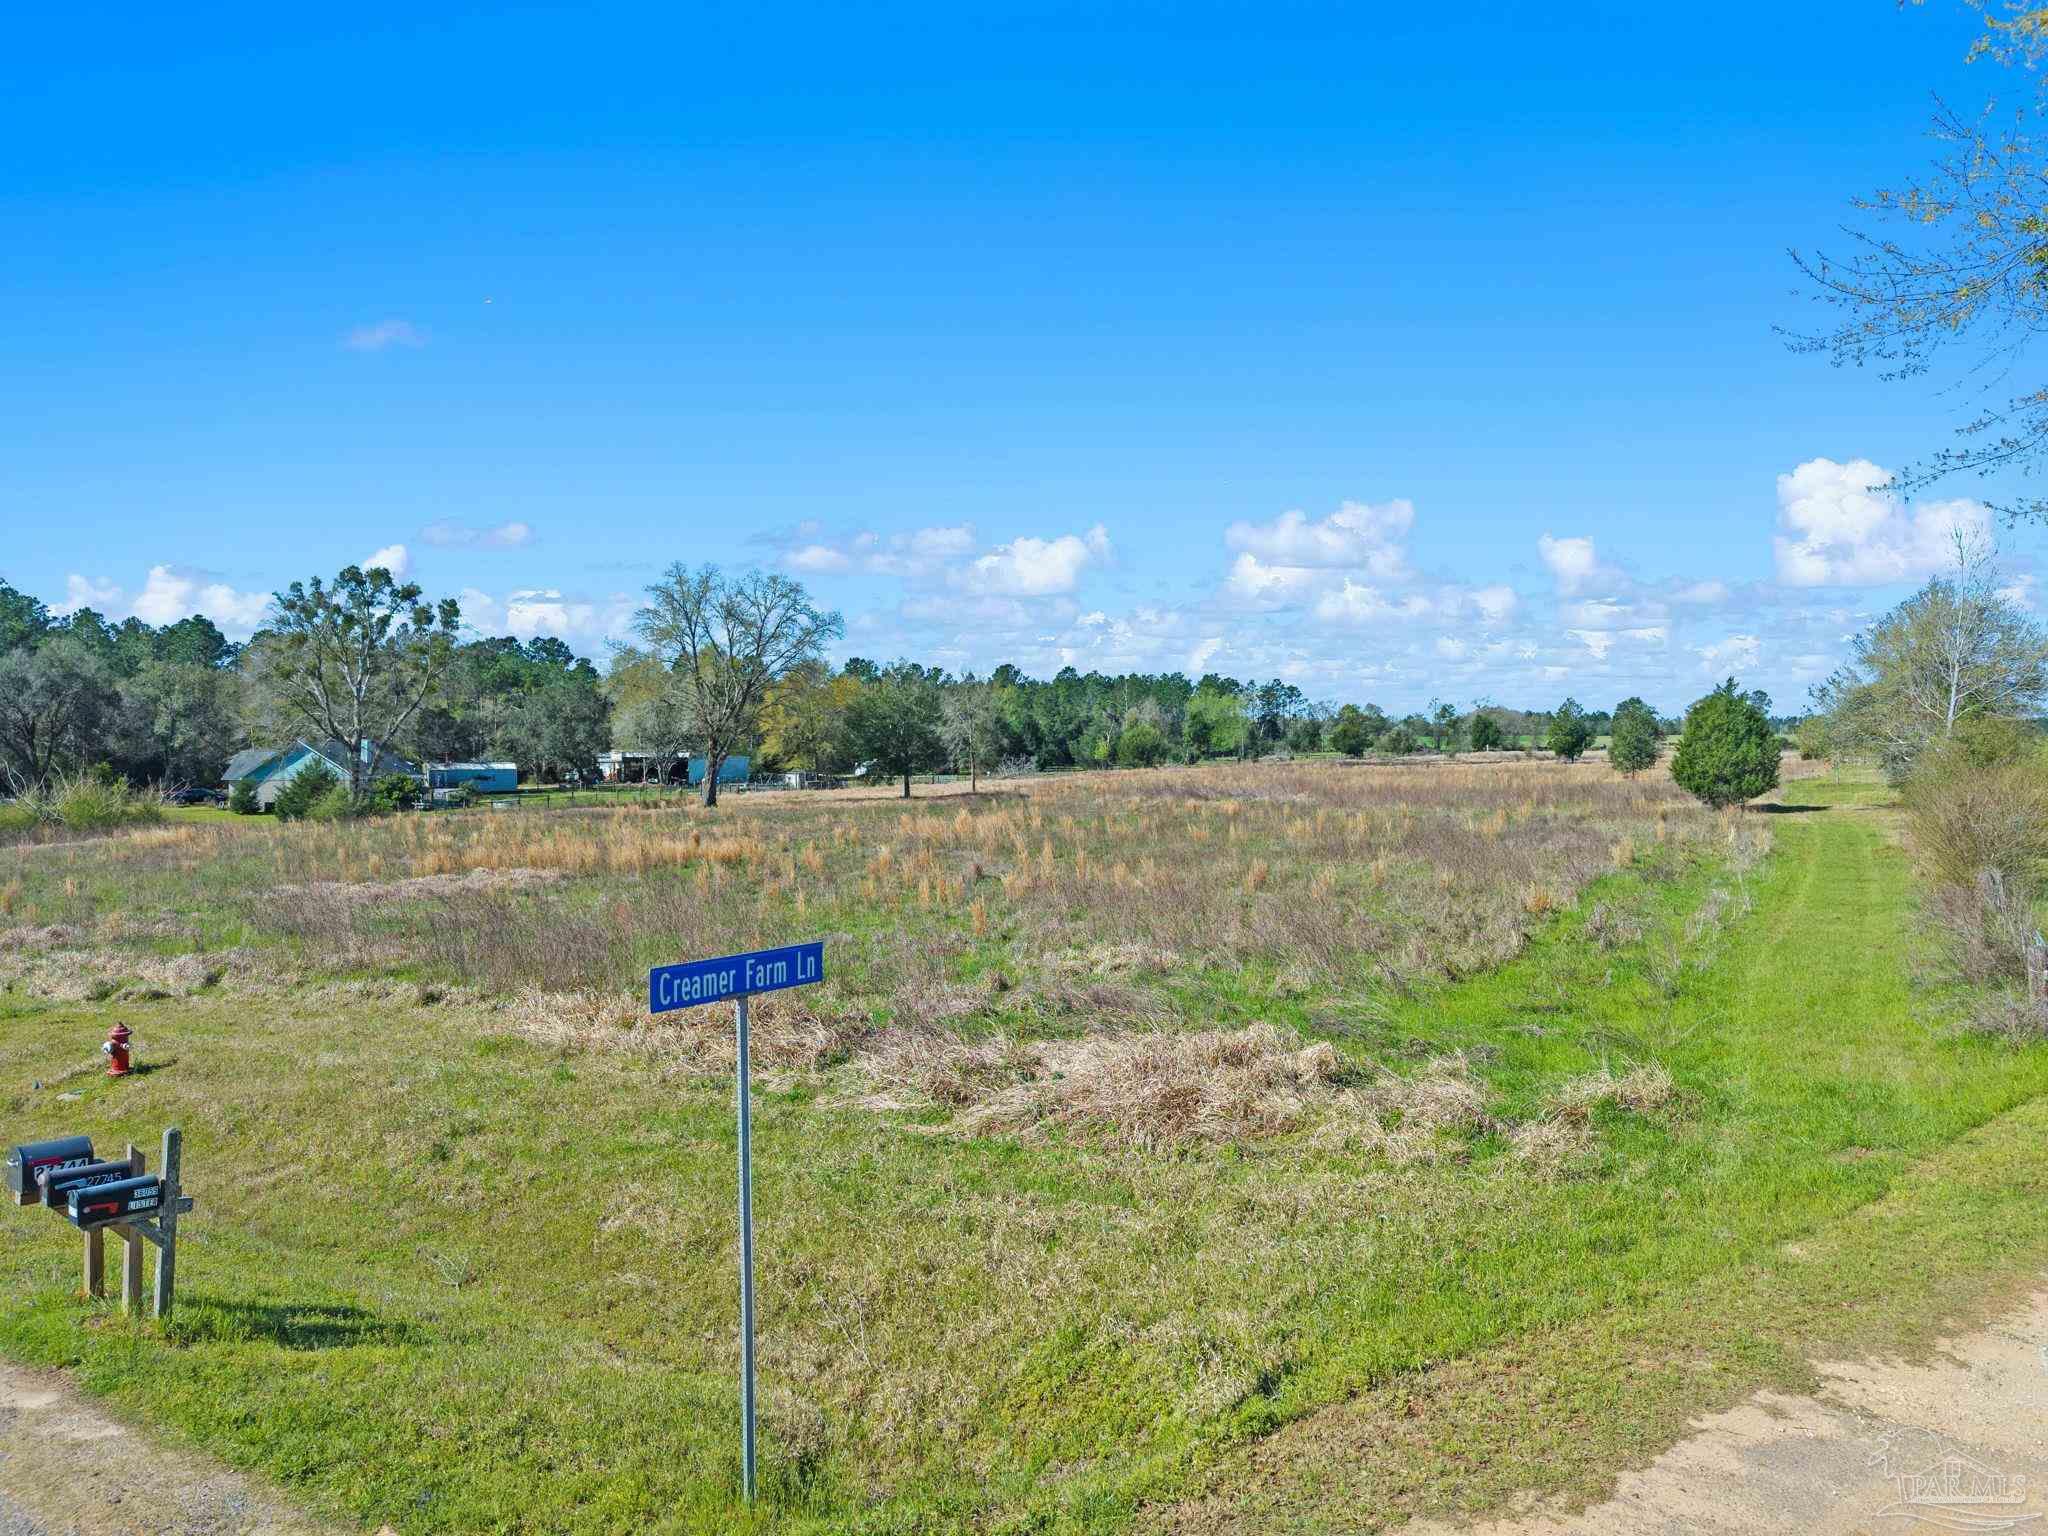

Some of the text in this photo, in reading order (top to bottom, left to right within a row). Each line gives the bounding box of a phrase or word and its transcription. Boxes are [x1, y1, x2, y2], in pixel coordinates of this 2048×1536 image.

[659, 951, 815, 1005] Creamer Farm Ln
